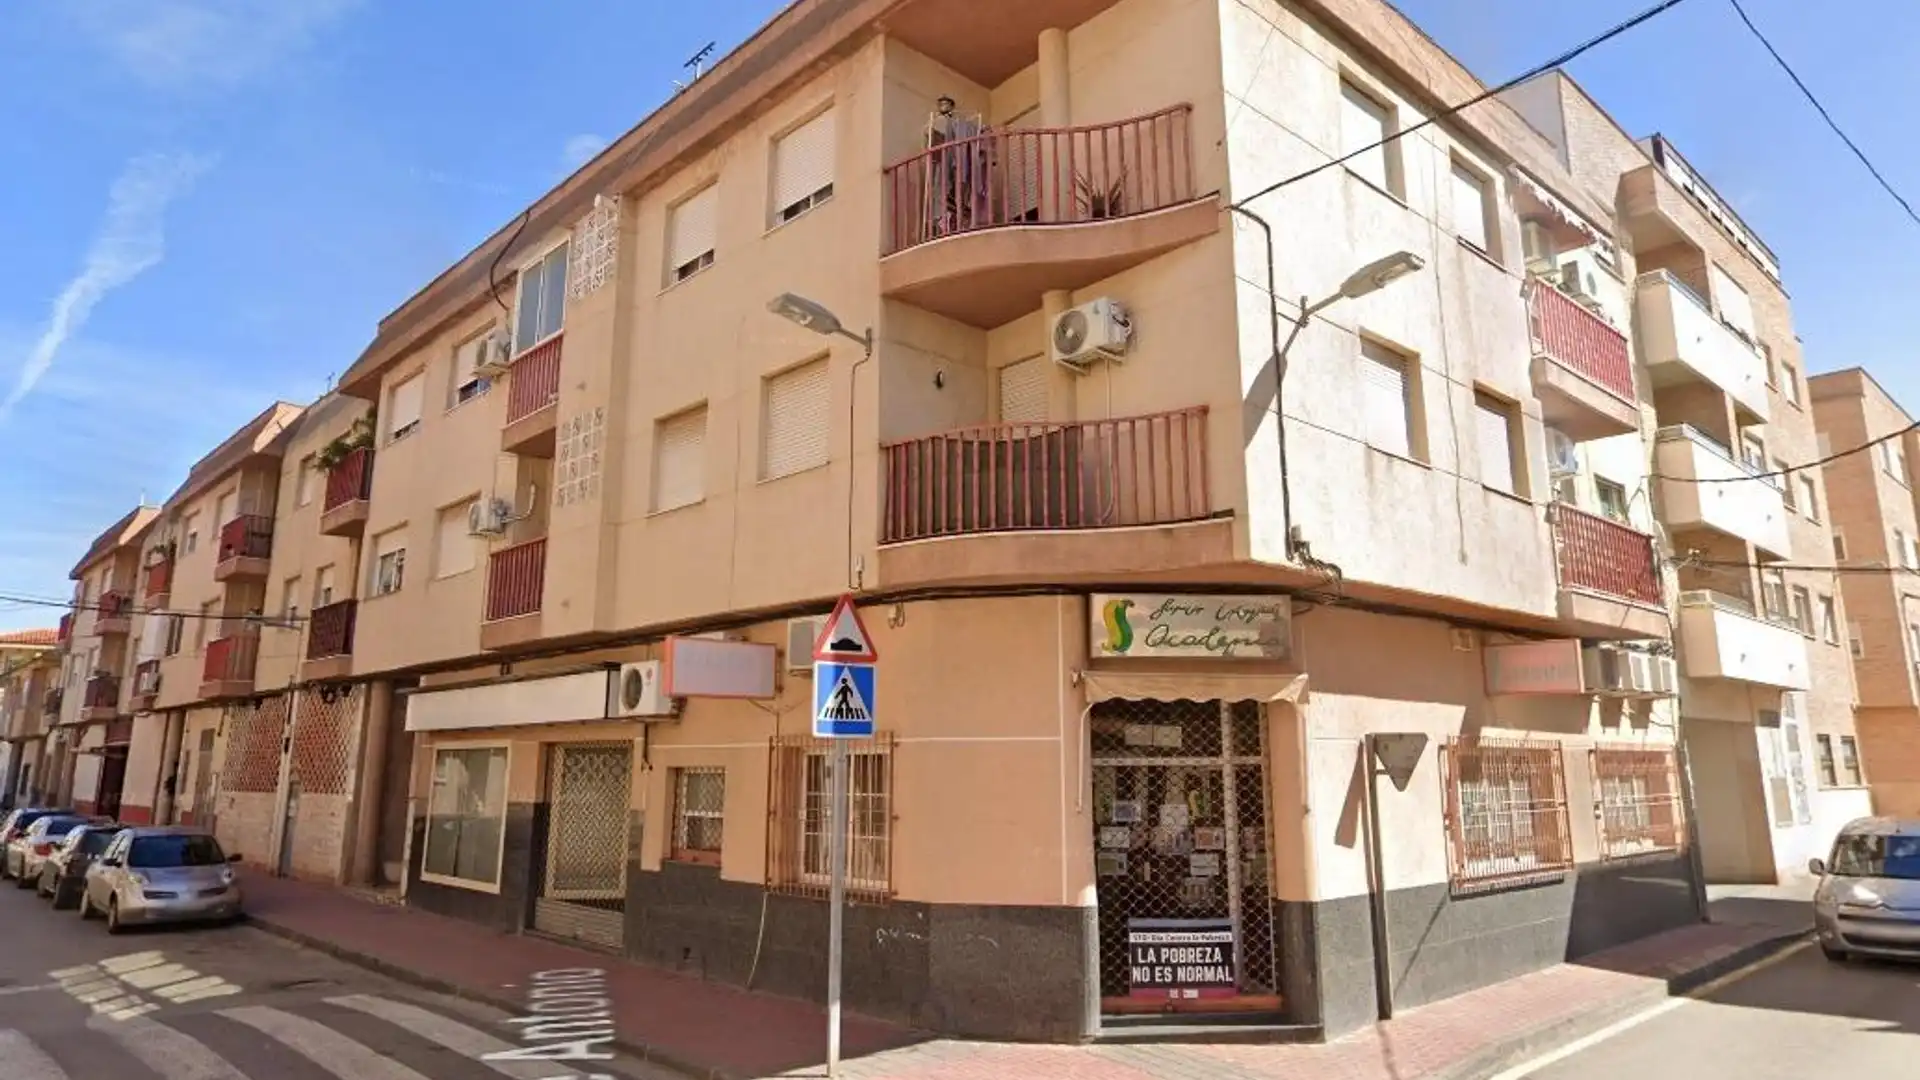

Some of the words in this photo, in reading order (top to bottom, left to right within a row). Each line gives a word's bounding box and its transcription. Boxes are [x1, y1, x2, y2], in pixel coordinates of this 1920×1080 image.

[1137, 946, 1157, 964] LA
[1160, 946, 1223, 964] POBREZA
[1132, 965, 1151, 983] NO
[1154, 965, 1173, 983] ES
[1177, 965, 1234, 983] NORMAL
